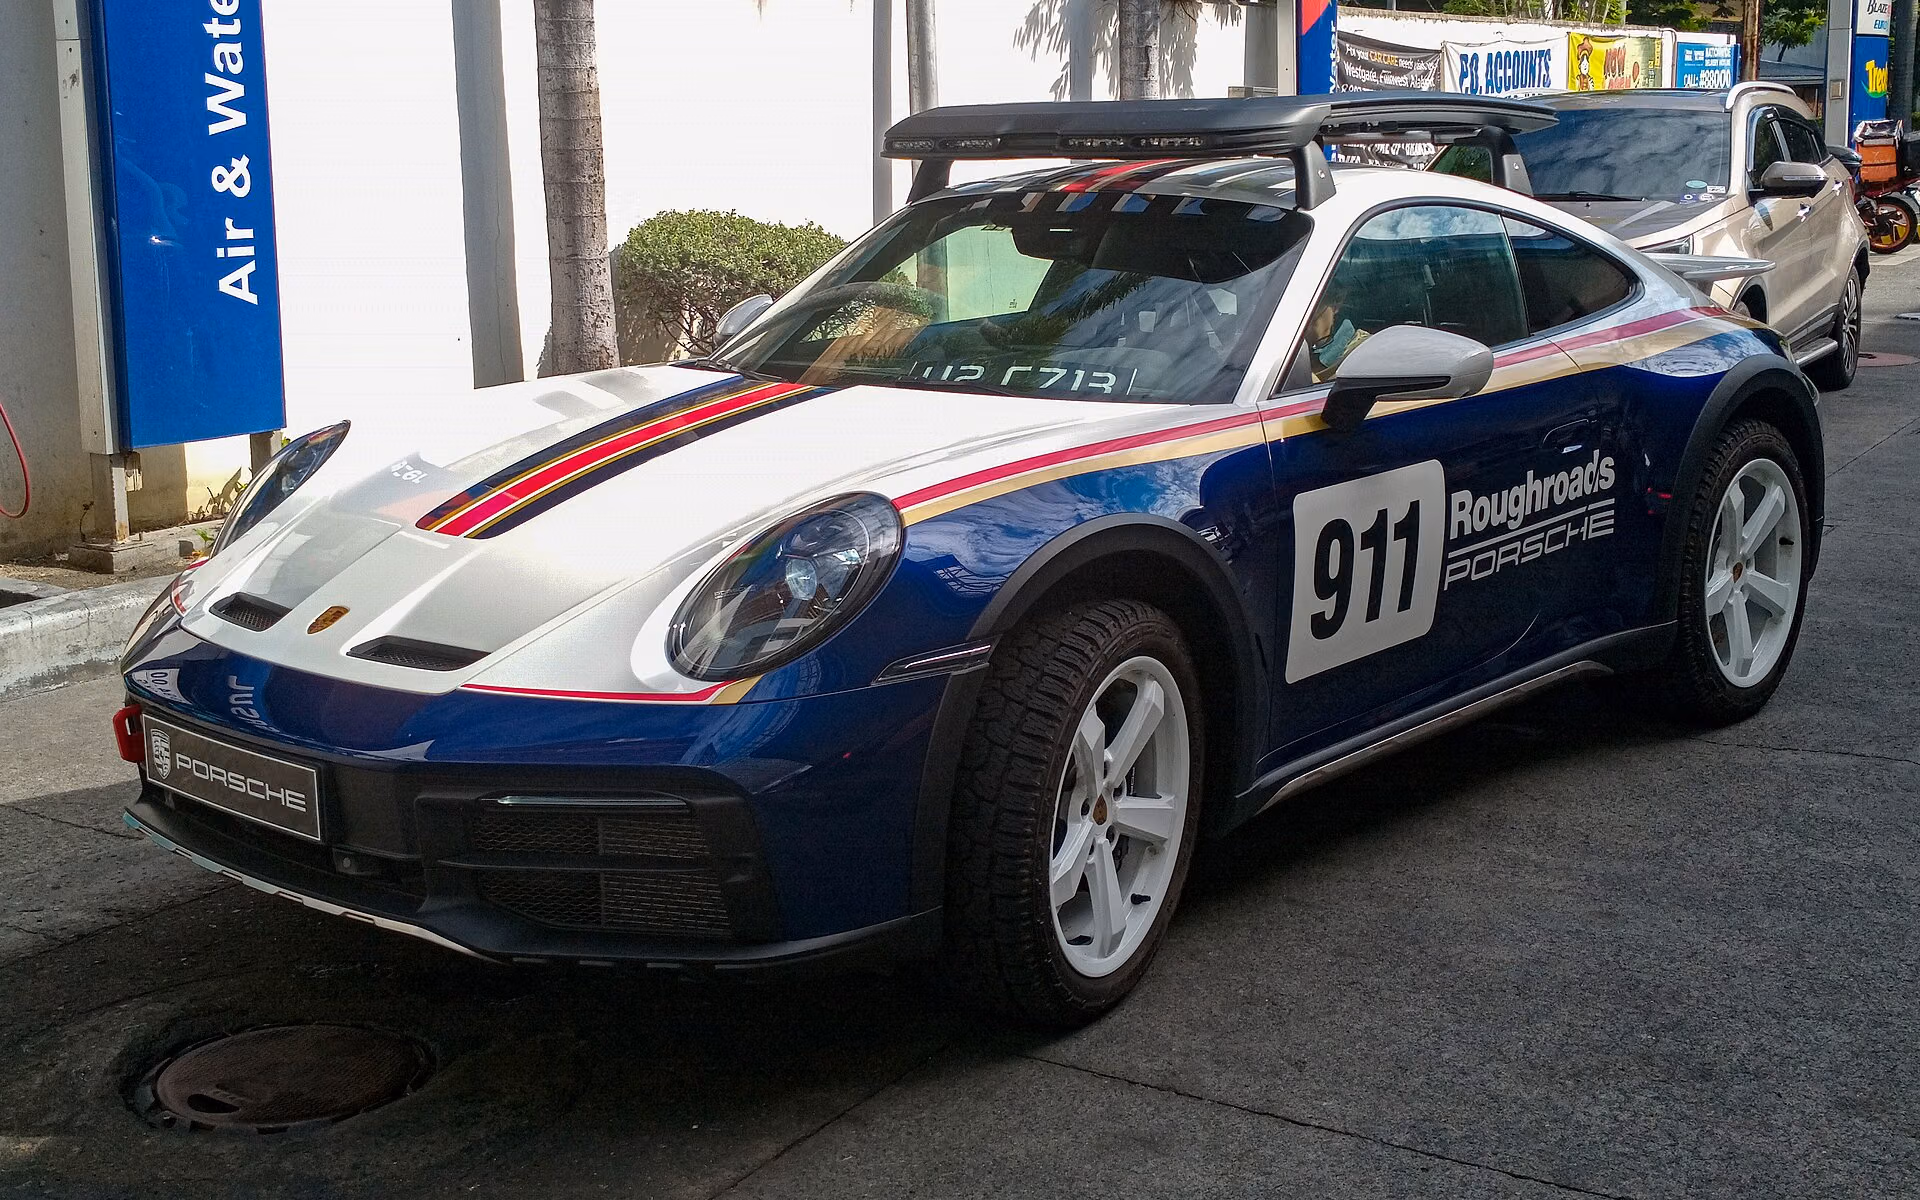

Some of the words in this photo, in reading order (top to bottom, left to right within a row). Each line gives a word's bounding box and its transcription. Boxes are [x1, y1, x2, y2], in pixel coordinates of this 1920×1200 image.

[1369, 51, 1383, 64] CAR
[1383, 54, 1399, 67] CARE
[1485, 49, 1551, 94] ACCOUNTS
[211, 154, 251, 198] &
[216, 216, 259, 306] Air
[1450, 449, 1616, 540] Roughroads
[1311, 500, 1421, 640] 911
[1444, 510, 1615, 591] PORSCHE
[176, 753, 307, 813] PORSCHE
